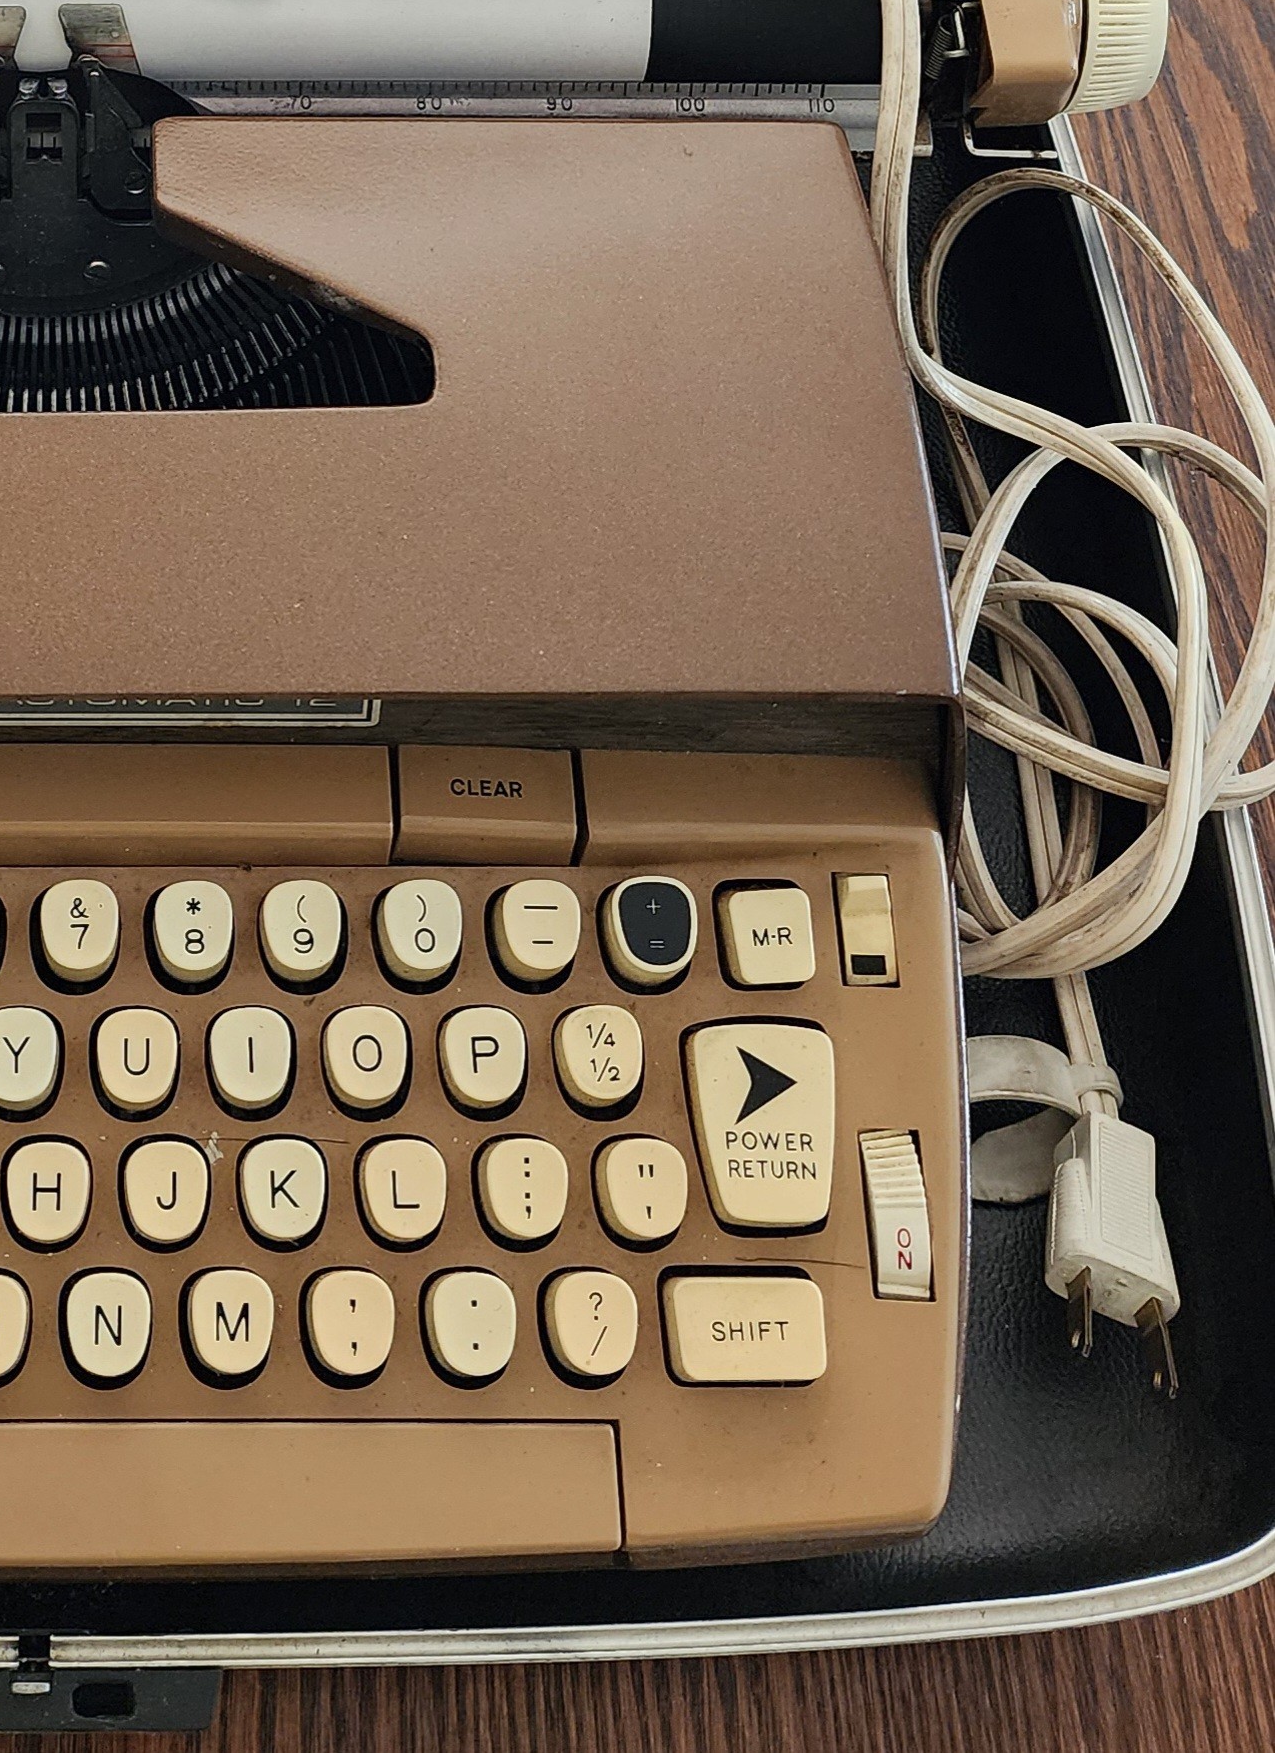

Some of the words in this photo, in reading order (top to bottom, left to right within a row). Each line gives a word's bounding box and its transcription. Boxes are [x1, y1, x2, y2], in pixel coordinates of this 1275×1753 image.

[546, 95, 573, 111] 90
[675, 97, 705, 112] 100
[808, 98, 835, 113] 110
[451, 779, 522, 798] CLEAR
[70, 924, 89, 949] 7
[185, 929, 204, 954] 8
[294, 928, 314, 953] 9
[415, 928, 435, 953] 0
[753, 927, 792, 946] M-R
[3, 1037, 30, 1073] Y
[124, 1038, 149, 1075] U
[353, 1035, 382, 1072] O
[471, 1036, 499, 1073] P
[726, 1131, 813, 1151] POWER
[728, 1160, 816, 1179] RETURN
[33, 1173, 61, 1211] H
[157, 1172, 176, 1210] J
[271, 1170, 299, 1208] K
[392, 1171, 420, 1209] L
[898, 1229, 912, 1270] ON
[95, 1305, 121, 1346] N
[216, 1302, 249, 1342] M
[712, 1322, 788, 1341] SHIFT
